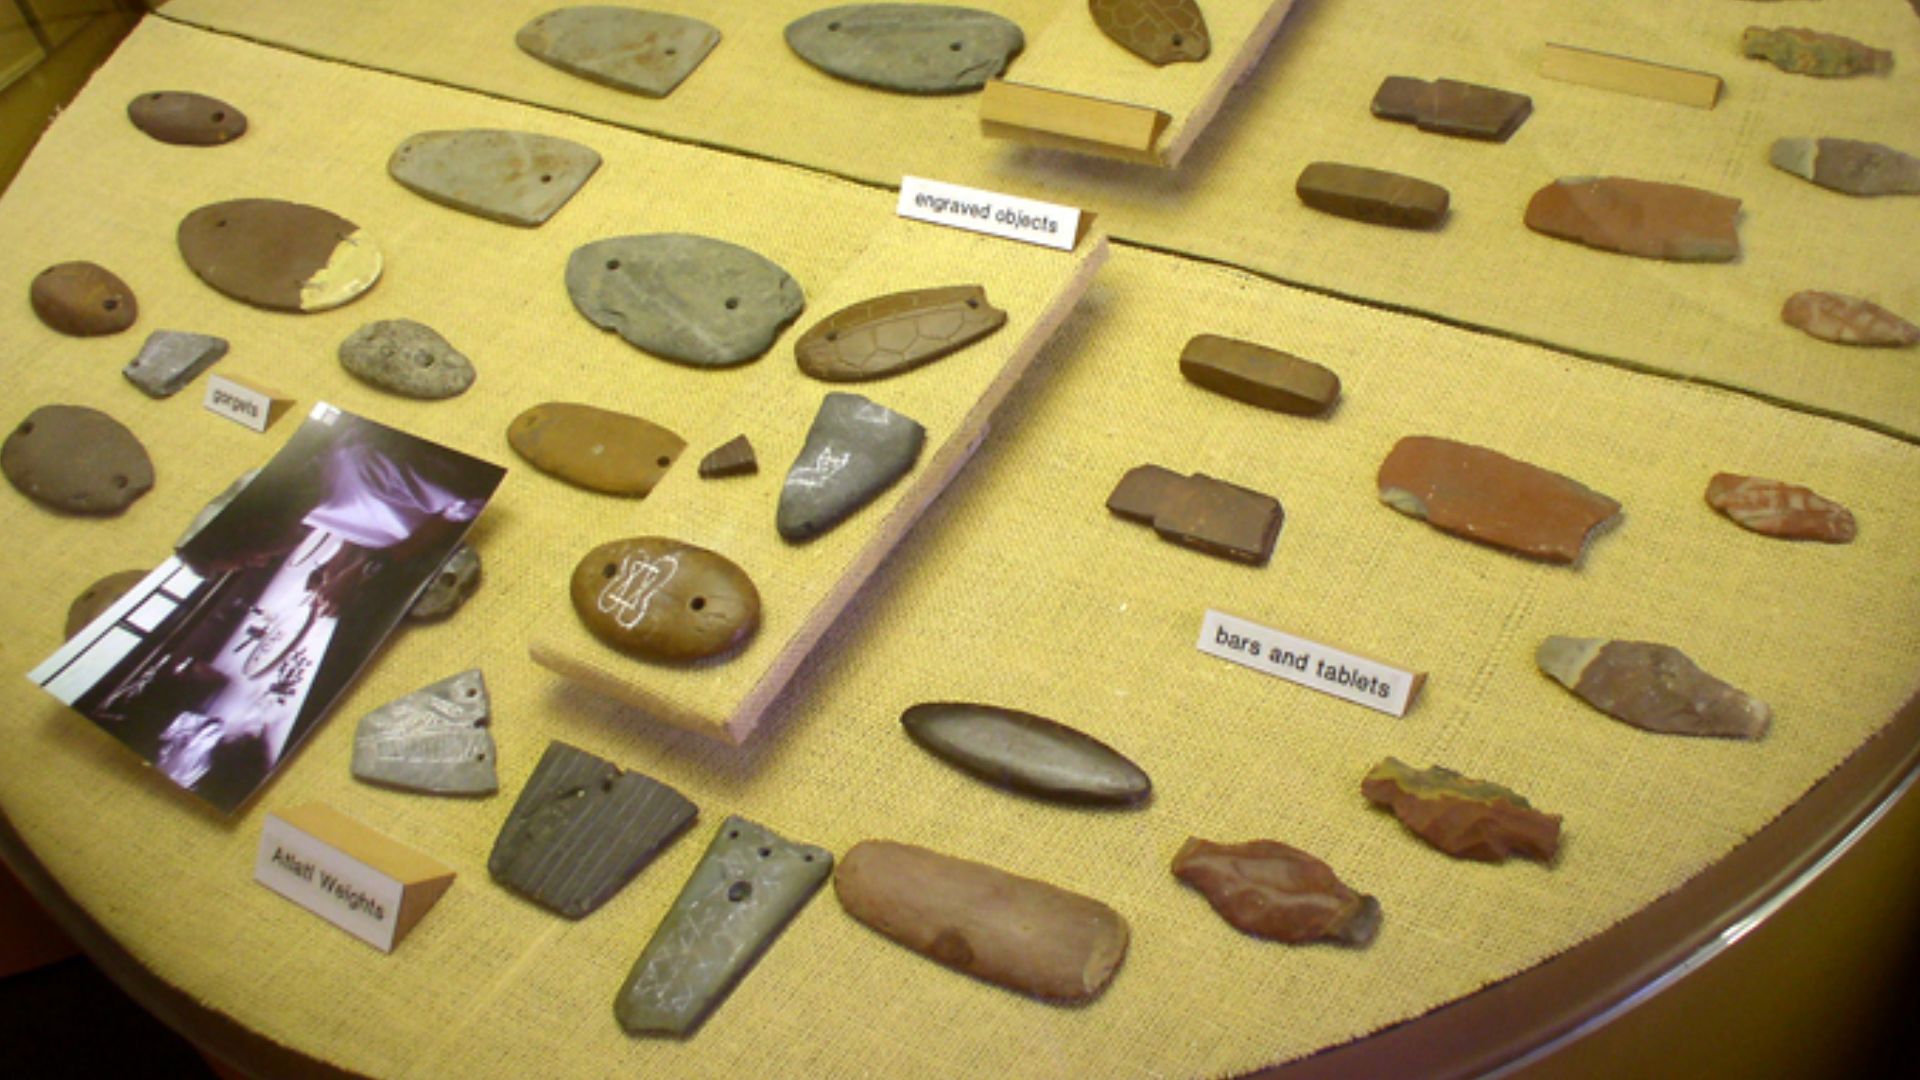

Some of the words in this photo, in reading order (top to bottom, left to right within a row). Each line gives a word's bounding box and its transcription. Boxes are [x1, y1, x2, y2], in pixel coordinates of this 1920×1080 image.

[915, 191, 990, 219] engraved
[995, 208, 1058, 233] objects
[1215, 625, 1262, 656] bars
[1268, 647, 1310, 672] and
[1315, 659, 1391, 698] tablets
[271, 846, 315, 882] Atlatl
[319, 871, 385, 922] Weights
